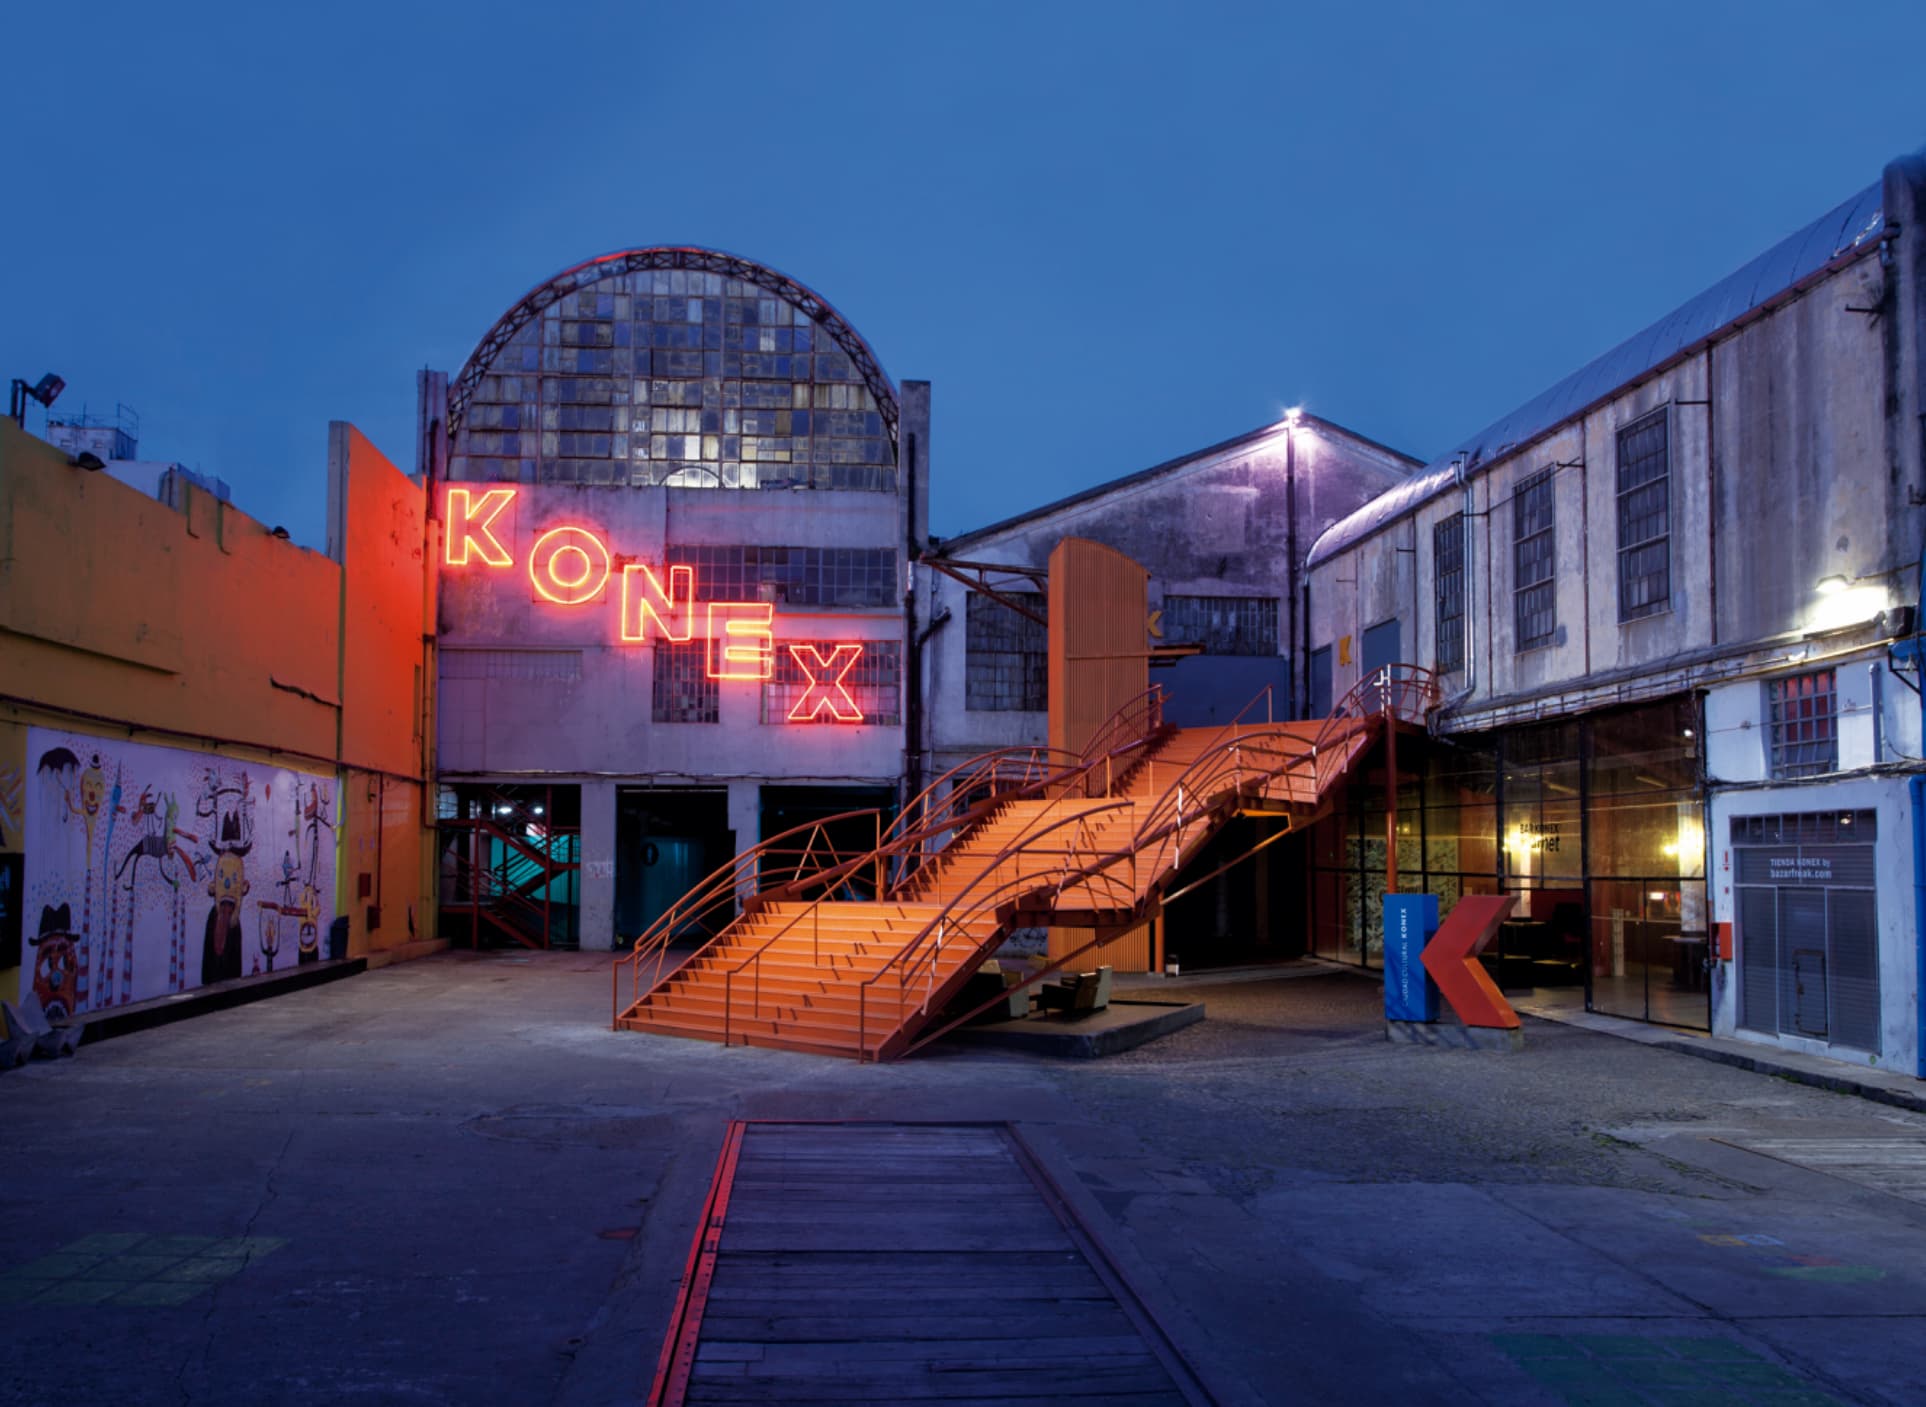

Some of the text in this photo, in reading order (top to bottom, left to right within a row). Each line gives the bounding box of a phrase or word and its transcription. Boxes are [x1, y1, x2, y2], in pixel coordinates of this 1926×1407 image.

[445, 488, 864, 721] KONEX
[1770, 858, 1795, 866] TIENDA
[1797, 858, 1821, 866] KONEX
[1770, 868, 1832, 878] bazarfreak.com
[1401, 942, 1409, 977] CULTURAL
